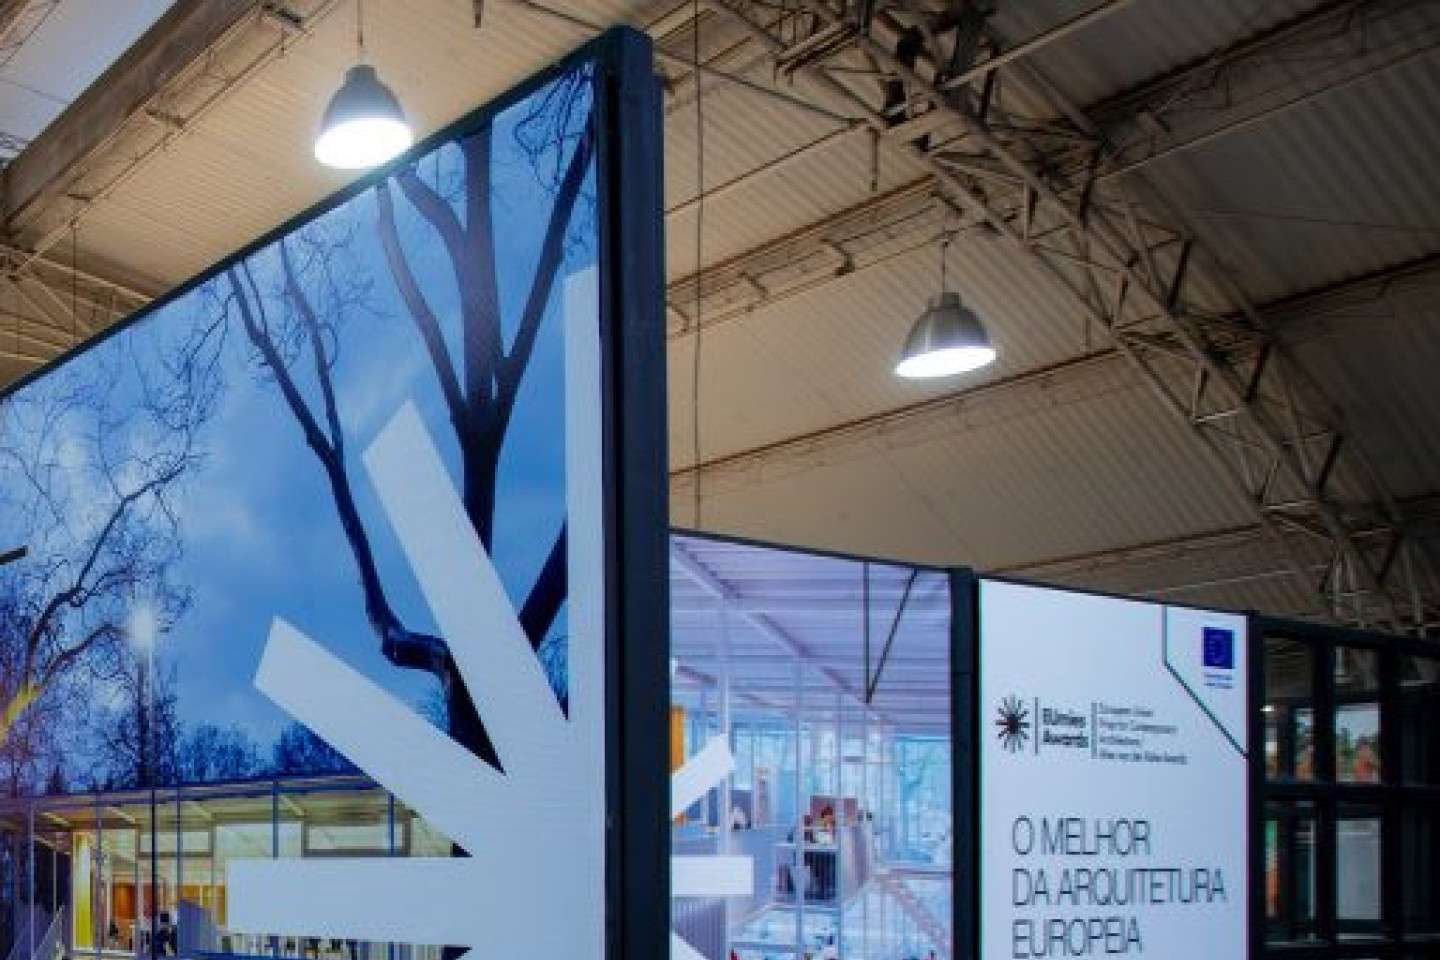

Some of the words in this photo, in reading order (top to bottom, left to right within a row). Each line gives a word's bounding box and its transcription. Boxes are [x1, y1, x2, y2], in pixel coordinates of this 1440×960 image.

[1012, 815, 1034, 856] O
[1041, 816, 1151, 856] MELHOR
[1012, 867, 1050, 906] DA
[1057, 867, 1228, 906] ARQUITETURA
[1012, 916, 1142, 959] EUROPEIA
